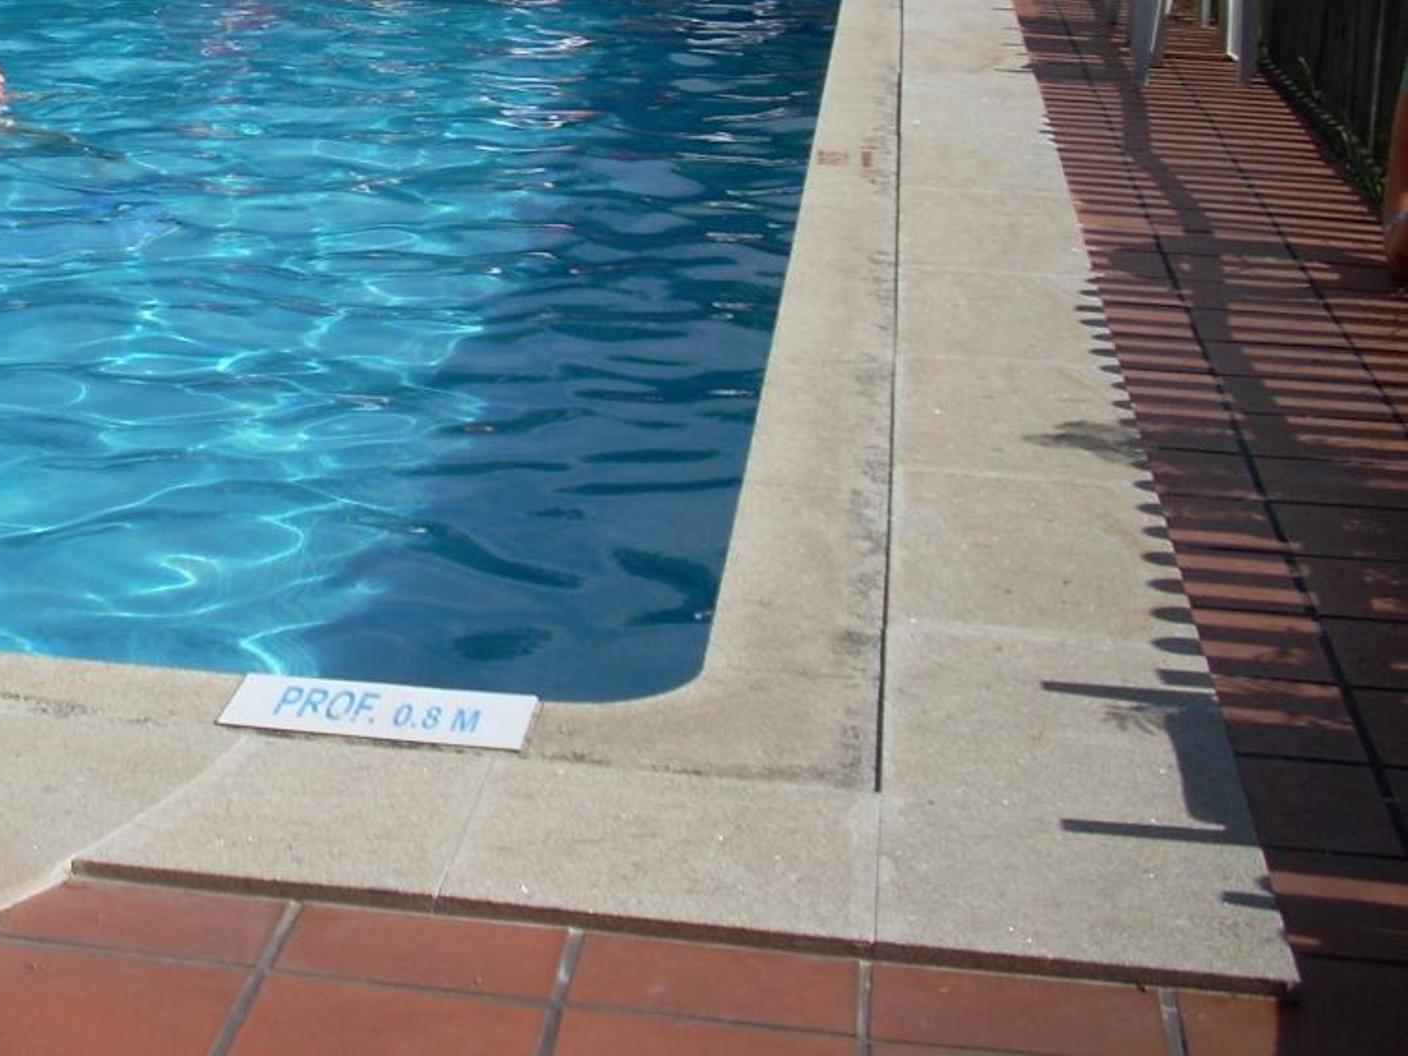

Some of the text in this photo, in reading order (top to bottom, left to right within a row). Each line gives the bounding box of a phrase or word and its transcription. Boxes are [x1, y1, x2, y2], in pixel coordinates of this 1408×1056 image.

[273, 685, 482, 733] PROF. 0.8 M
